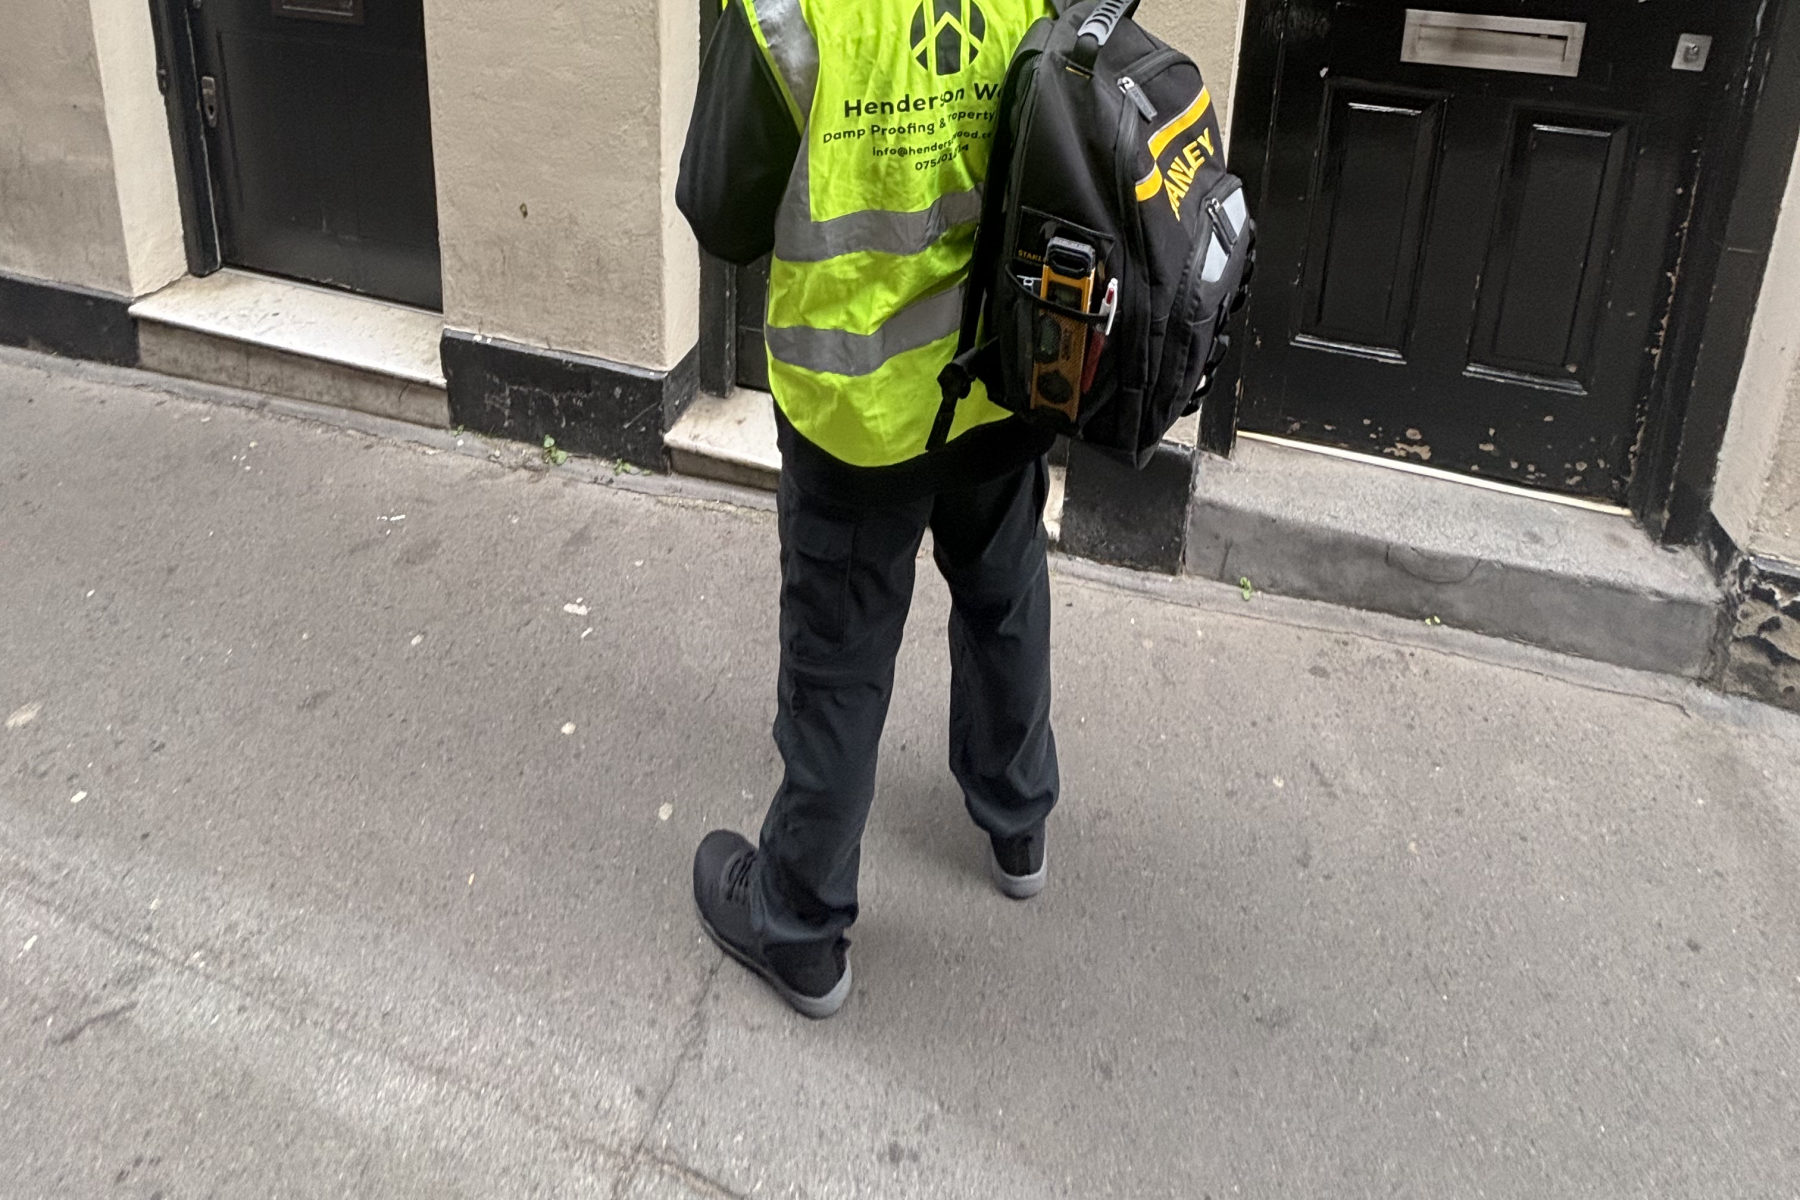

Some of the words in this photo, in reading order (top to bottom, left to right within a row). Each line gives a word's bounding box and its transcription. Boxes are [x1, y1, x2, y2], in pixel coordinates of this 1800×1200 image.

[844, 87, 965, 118] Henderson
[973, 82, 1001, 101] W
[823, 128, 866, 144] Damp
[871, 122, 935, 136] Proofing
[939, 117, 946, 128] &
[948, 110, 995, 123] roperty
[1163, 127, 1215, 222] ANLEY
[1018, 249, 1048, 264] STANL
